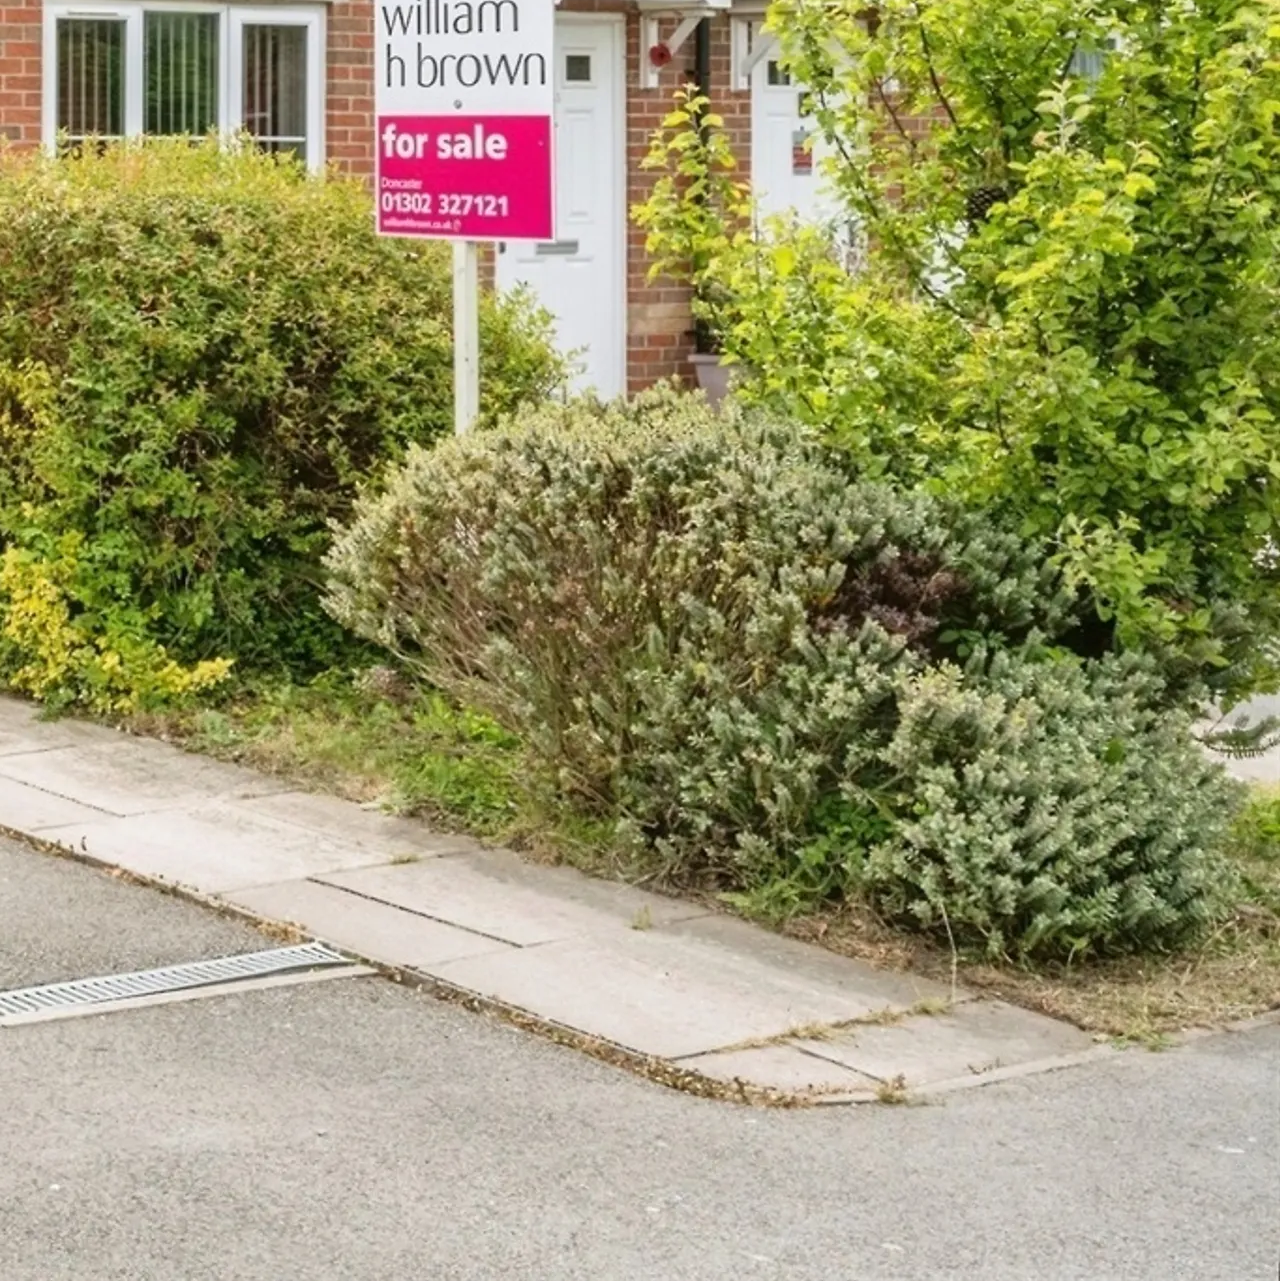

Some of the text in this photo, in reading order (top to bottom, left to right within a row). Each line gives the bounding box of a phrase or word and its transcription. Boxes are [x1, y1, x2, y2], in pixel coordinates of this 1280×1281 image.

[386, 42, 546, 88] h brown
[381, 123, 508, 160] for sale
[381, 191, 509, 217] 01302 327121
